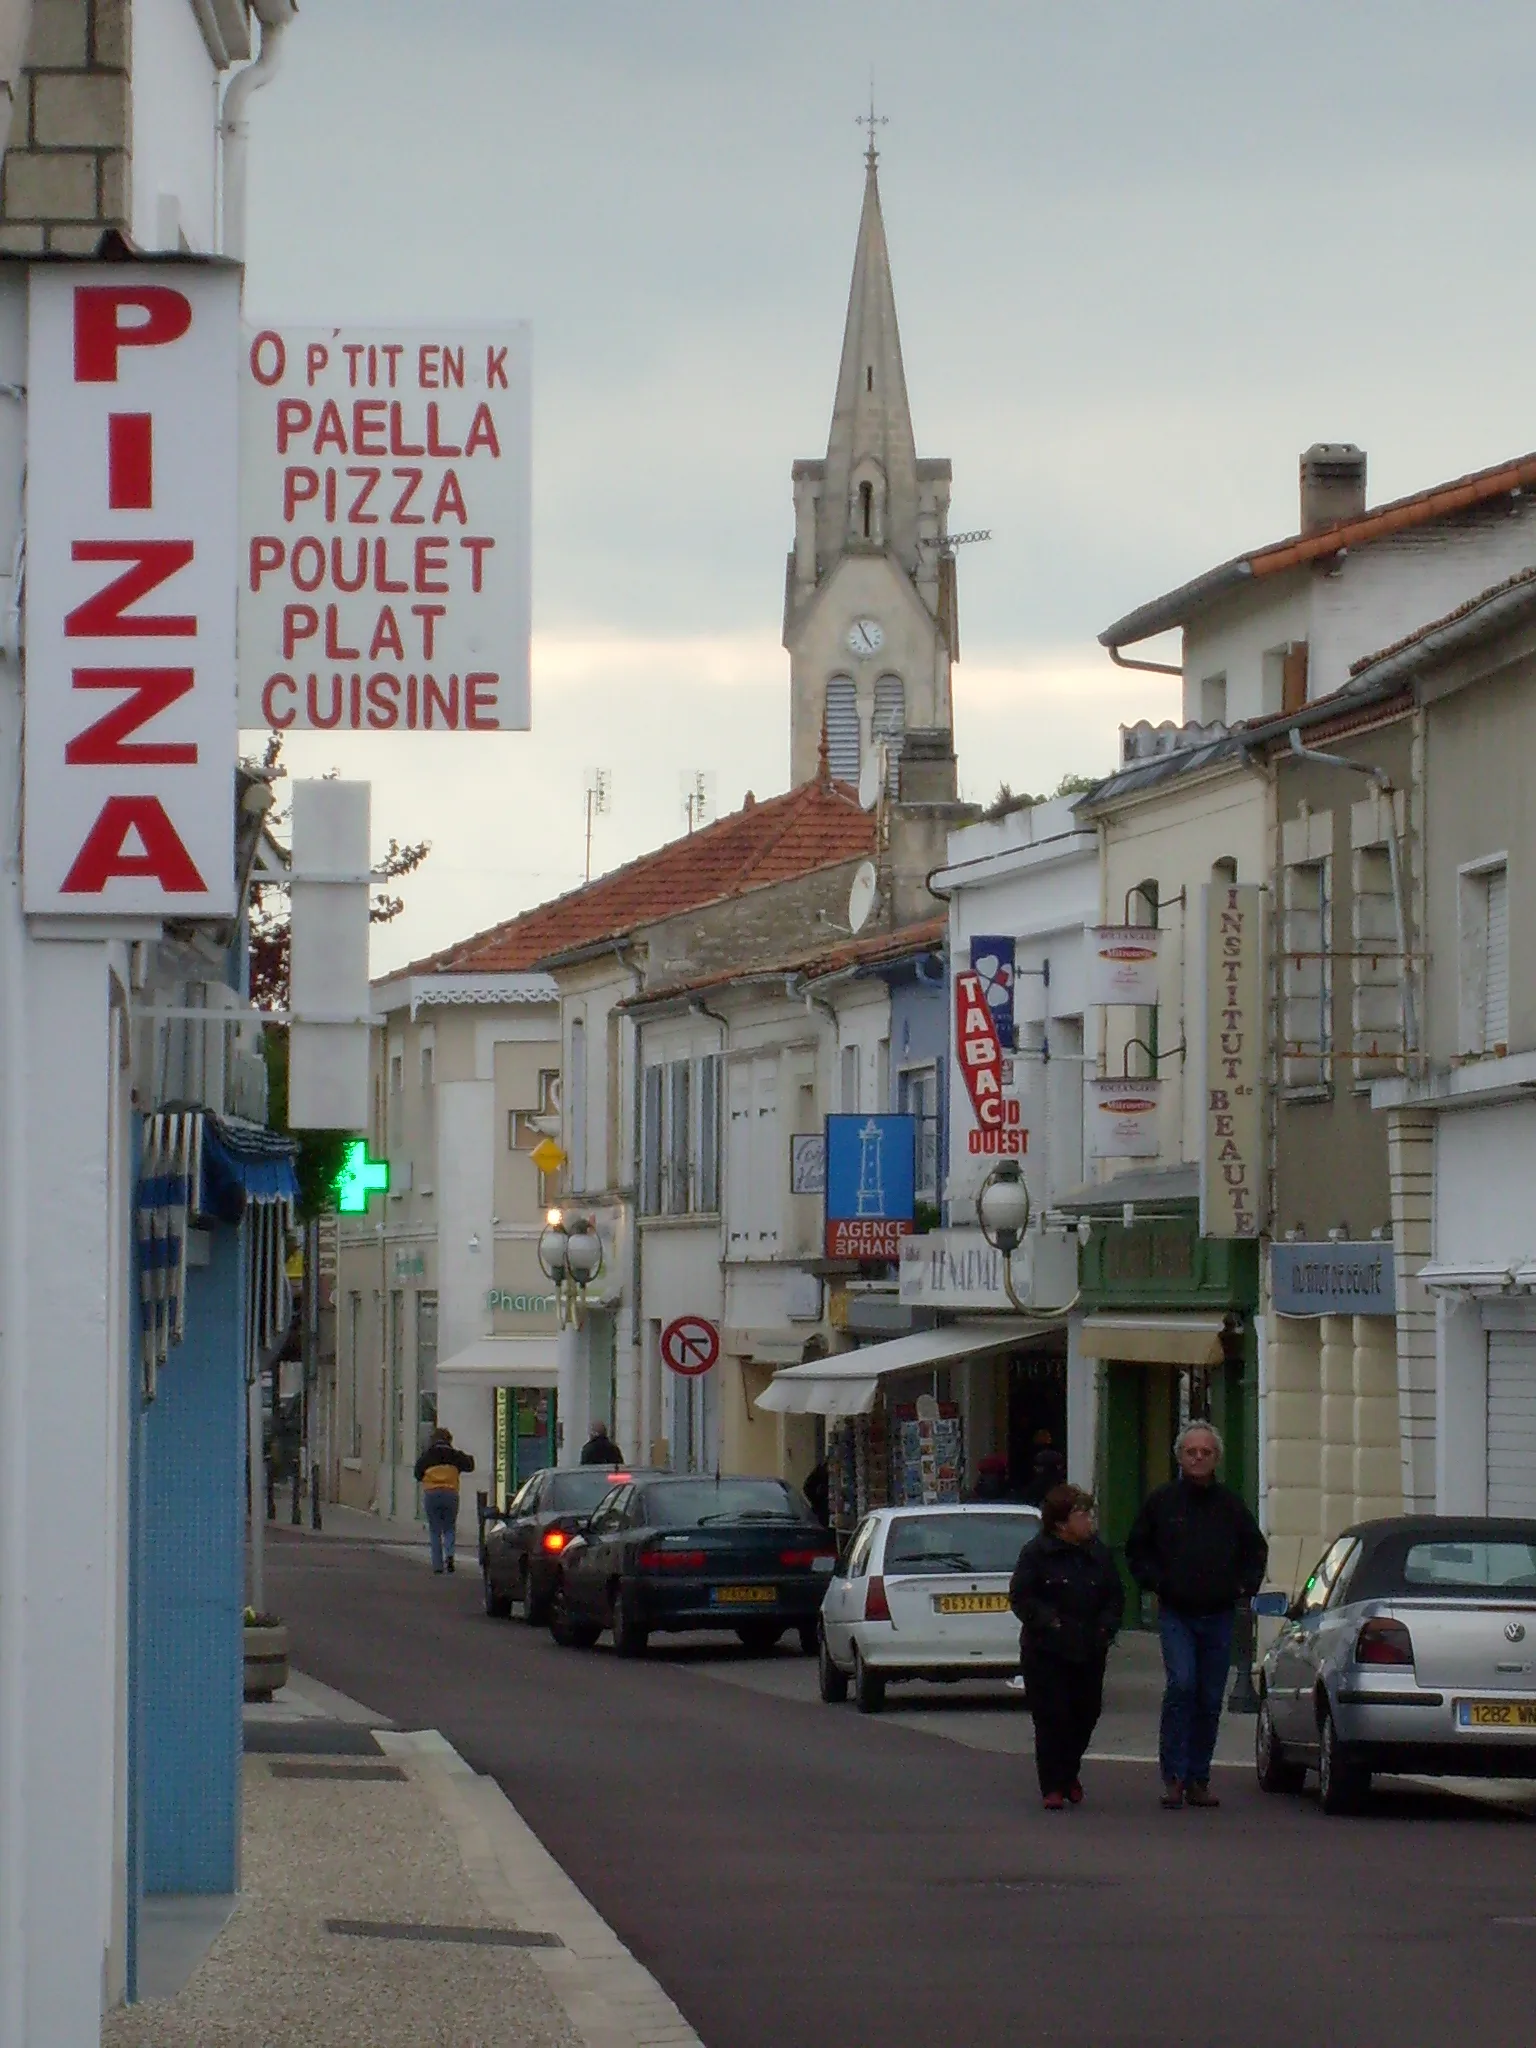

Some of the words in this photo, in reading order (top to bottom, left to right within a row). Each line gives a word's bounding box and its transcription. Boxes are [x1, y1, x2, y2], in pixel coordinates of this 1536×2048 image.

[250, 331, 287, 387] O
[418, 344, 465, 390] EN
[486, 346, 508, 389] K
[276, 399, 501, 459] PAELLA
[283, 466, 468, 526] PIZZA
[59, 285, 209, 893] PIZZA
[249, 536, 495, 595] POULET
[281, 603, 447, 661] PLAT
[261, 672, 500, 732] CUISINE
[1220, 889, 1244, 1079] INSTITUT
[959, 977, 1002, 1124] TABAC
[1235, 1084, 1253, 1096] de
[967, 1129, 1030, 1154] OUEST
[1209, 1090, 1256, 1236] BEAUTE
[835, 1239, 845, 1255] DU
[836, 1221, 906, 1237] AGENCE
[1473, 1706, 1511, 1722] 1282
